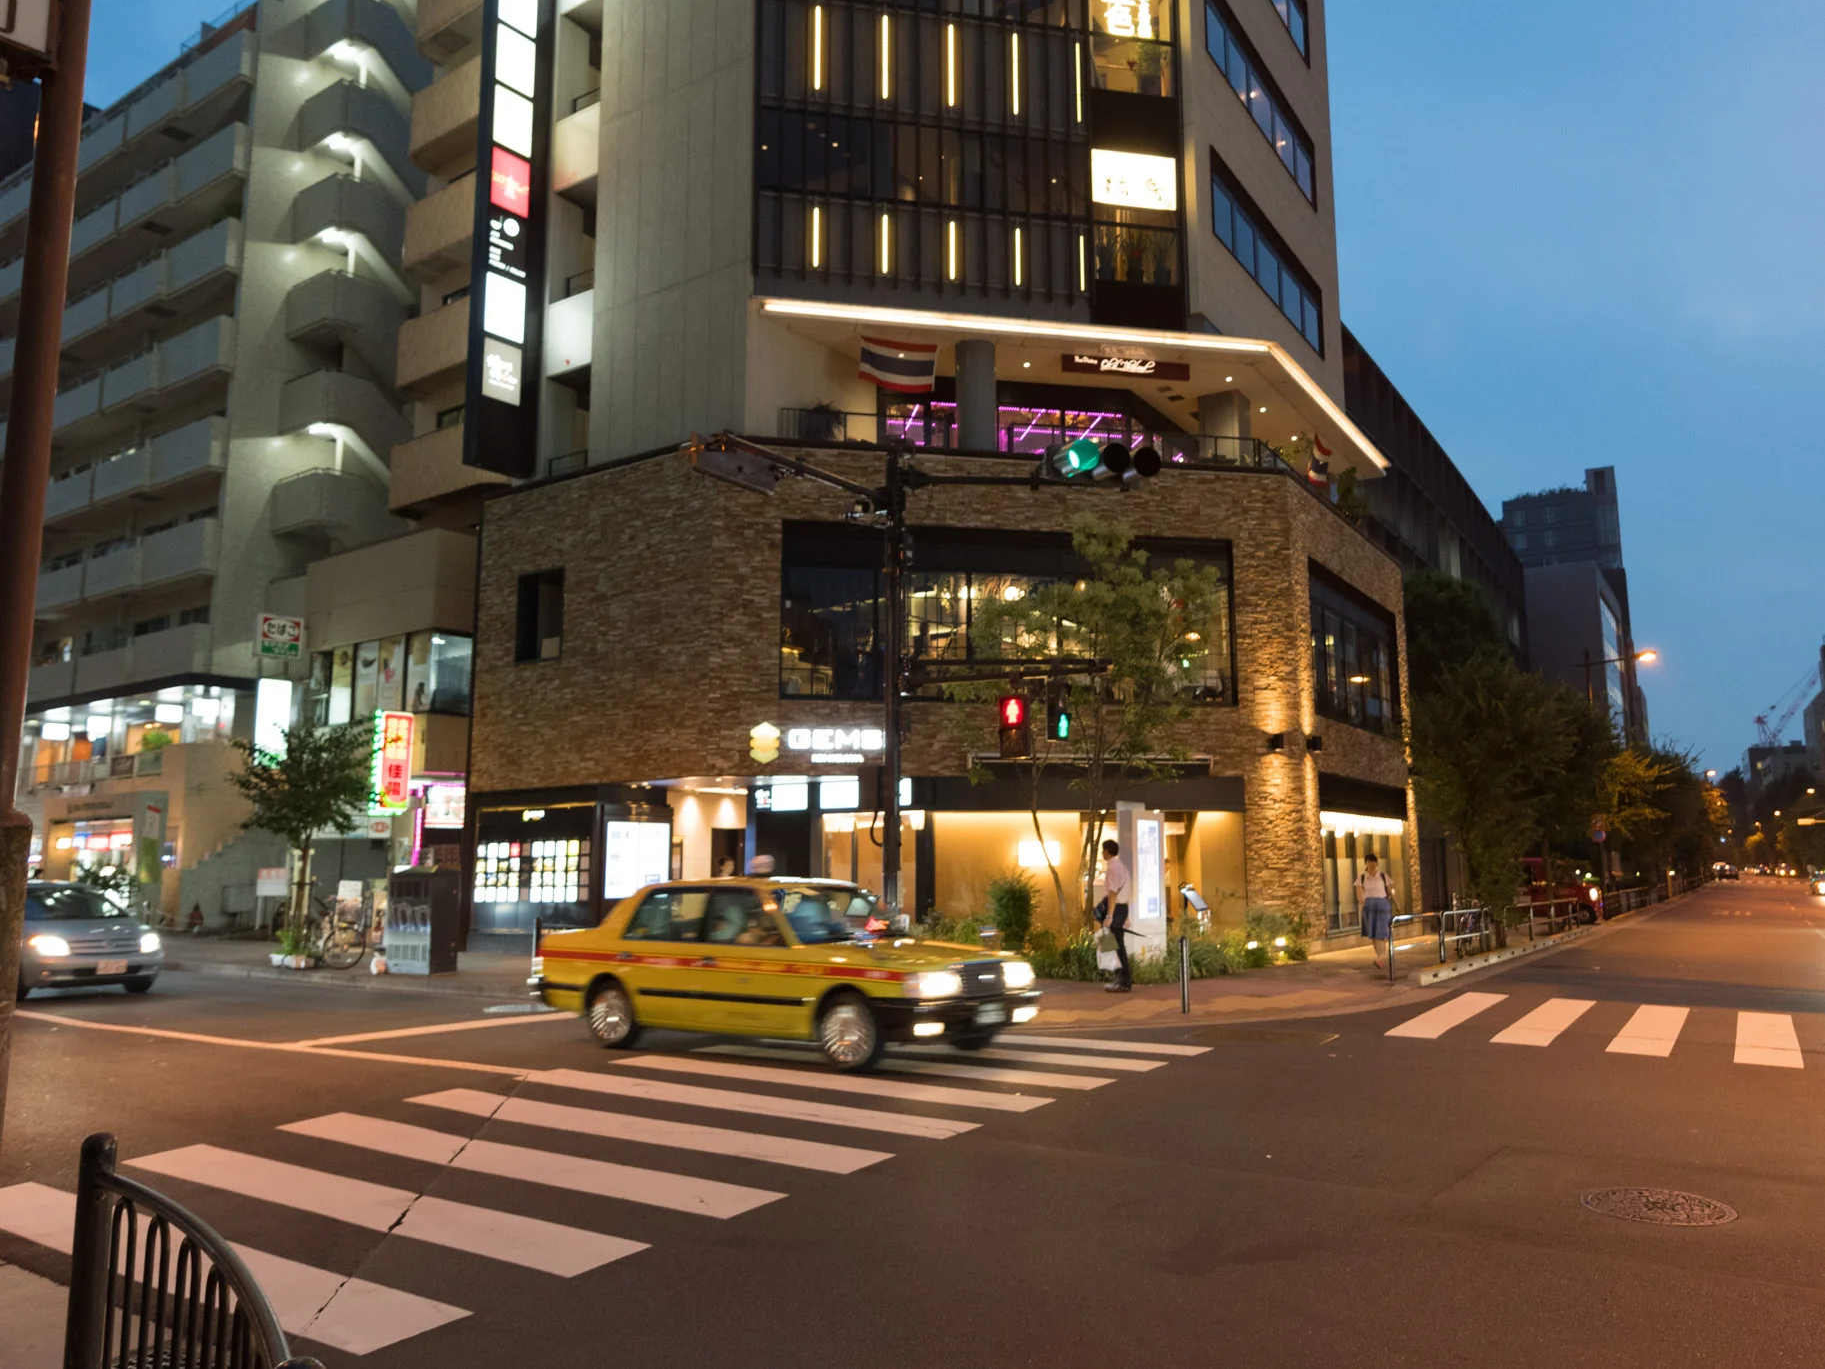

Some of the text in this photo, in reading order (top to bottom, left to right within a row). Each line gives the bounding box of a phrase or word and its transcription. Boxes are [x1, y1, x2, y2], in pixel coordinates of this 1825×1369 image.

[267, 621, 296, 637] たばこ
[788, 728, 883, 750] GEMS
